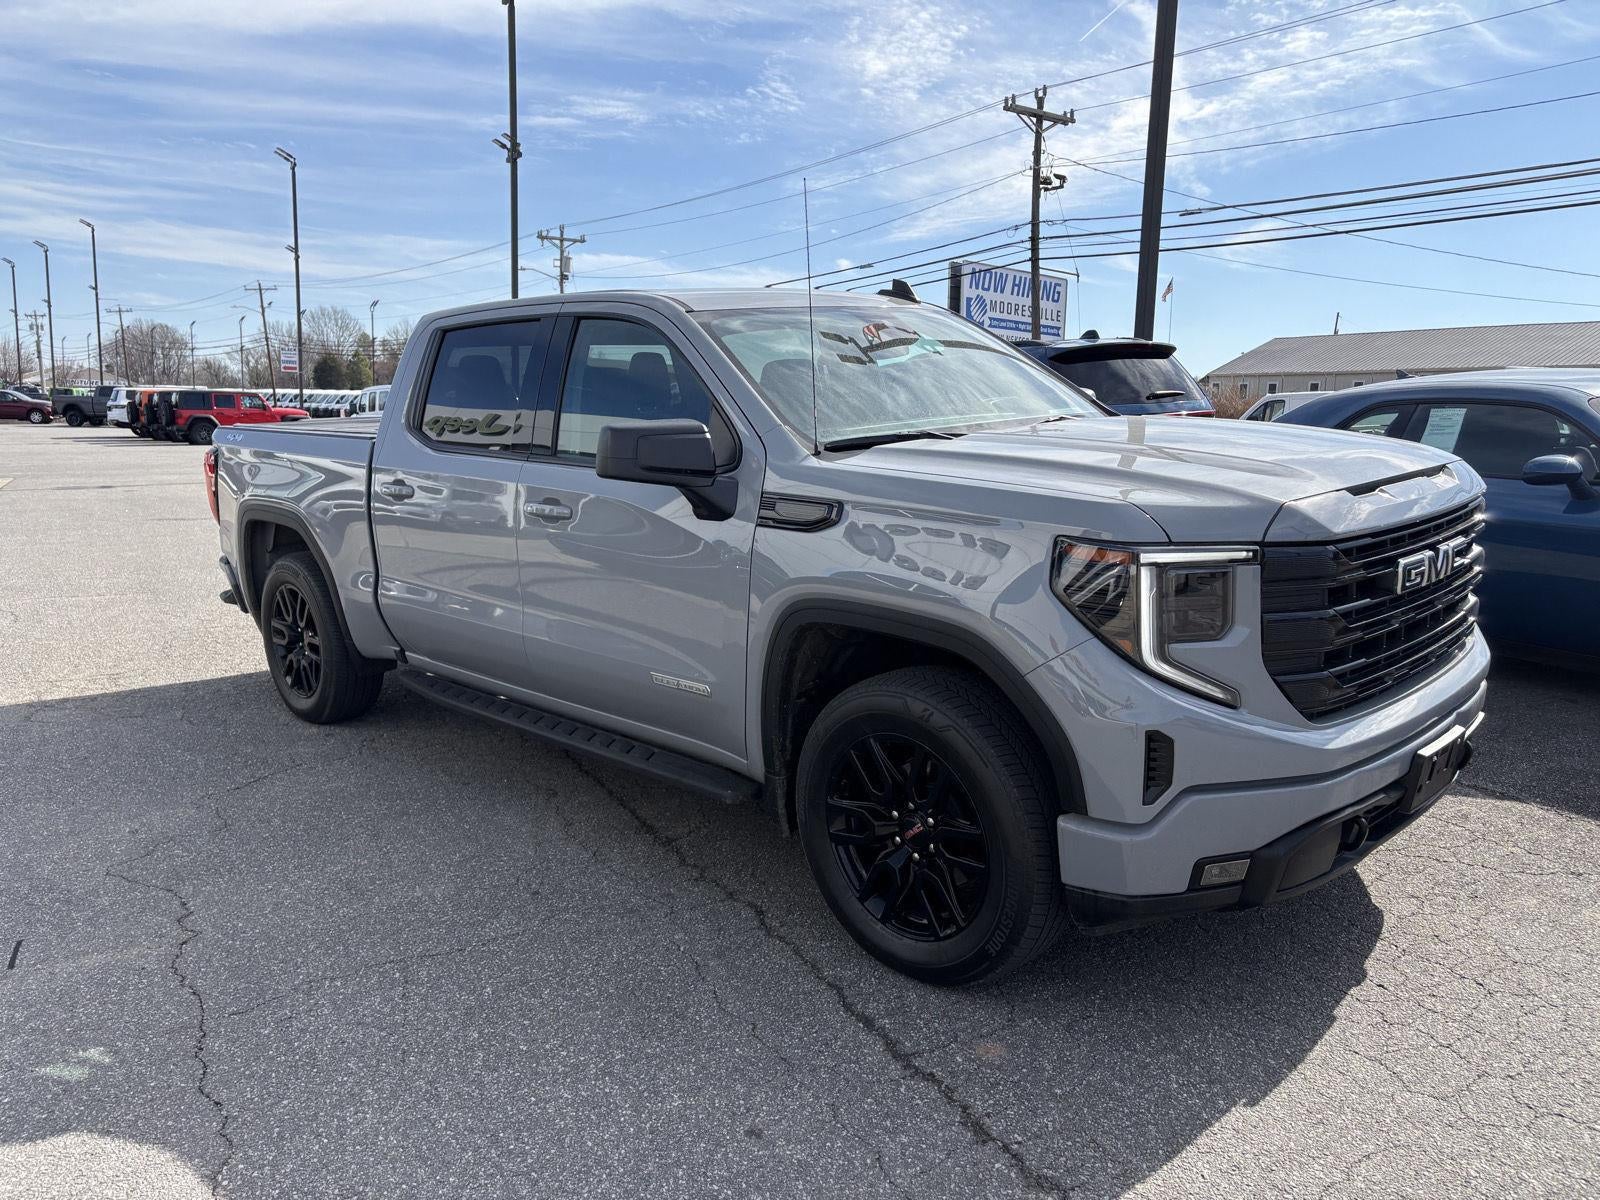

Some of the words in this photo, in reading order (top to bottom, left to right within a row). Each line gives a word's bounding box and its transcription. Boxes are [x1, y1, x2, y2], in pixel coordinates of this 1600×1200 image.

[969, 267, 1009, 294] NOW
[1010, 274, 1062, 303] HING
[989, 300, 1061, 322] MOORESILLE
[1397, 536, 1471, 595] GMC
[985, 860, 1020, 957] IDGESTONE
